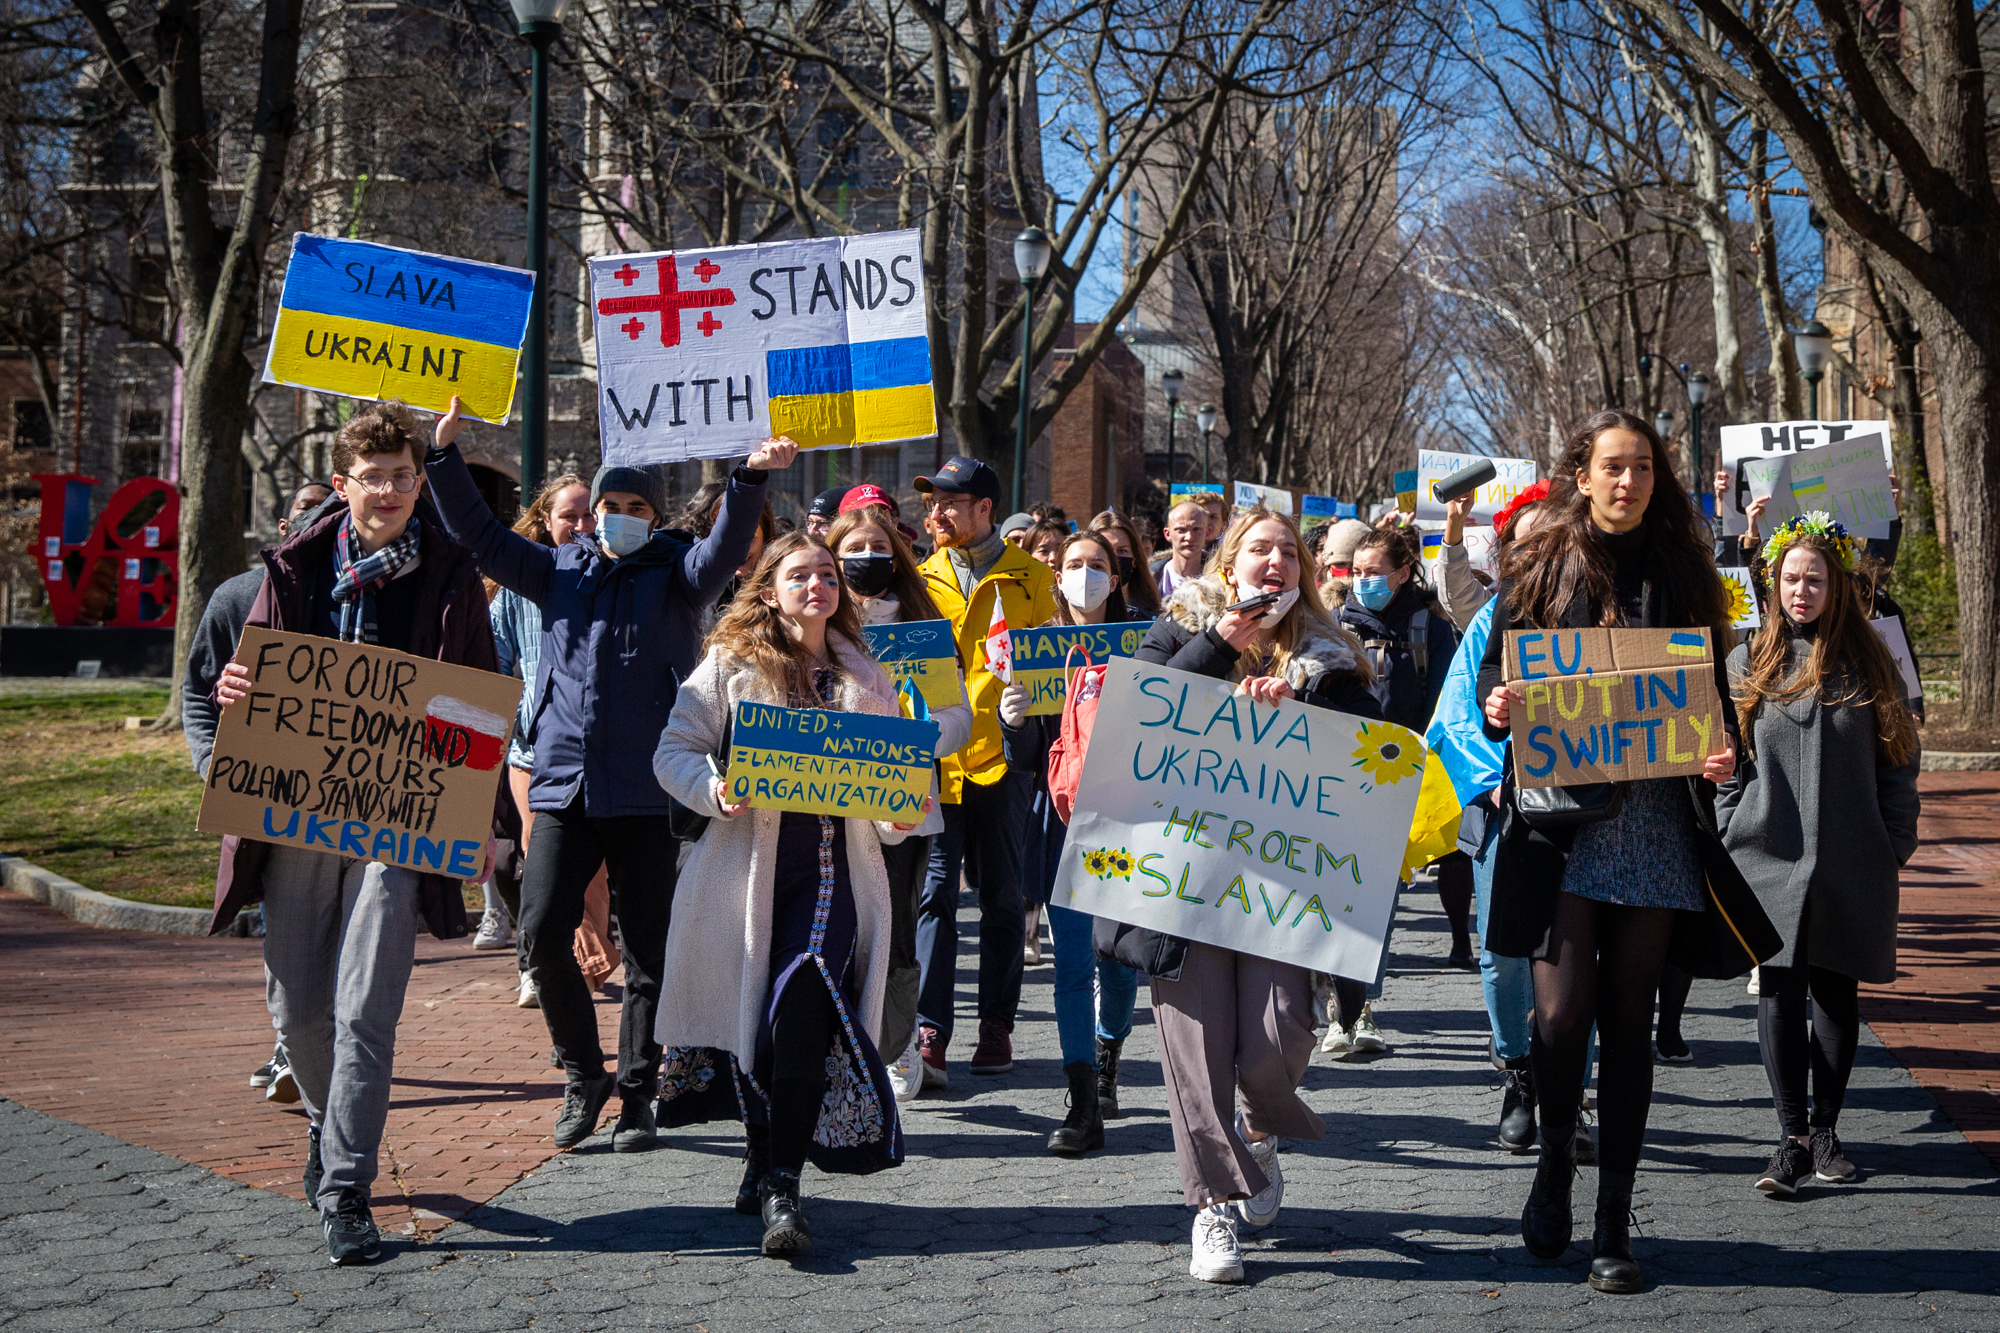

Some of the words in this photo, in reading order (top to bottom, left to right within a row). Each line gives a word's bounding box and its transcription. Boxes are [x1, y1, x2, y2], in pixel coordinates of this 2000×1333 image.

[341, 262, 456, 311] SLAVA
[749, 255, 916, 320] STANDS
[305, 329, 467, 382] UKRAINI
[606, 374, 754, 431] WITH
[1750, 466, 1782, 483] We
[1791, 454, 1834, 477] stand
[889, 660, 928, 675] THE
[1014, 630, 1111, 661] HANDS
[255, 642, 338, 692] FOR
[345, 653, 417, 707] OUR
[1526, 676, 1623, 722] PUT
[1634, 669, 1687, 711] IN
[322, 745, 446, 797] YOURS
[1524, 713, 1712, 778] SWIFTLY
[734, 775, 924, 813] ORGANIZATION
[263, 807, 481, 877] UKRAINE
